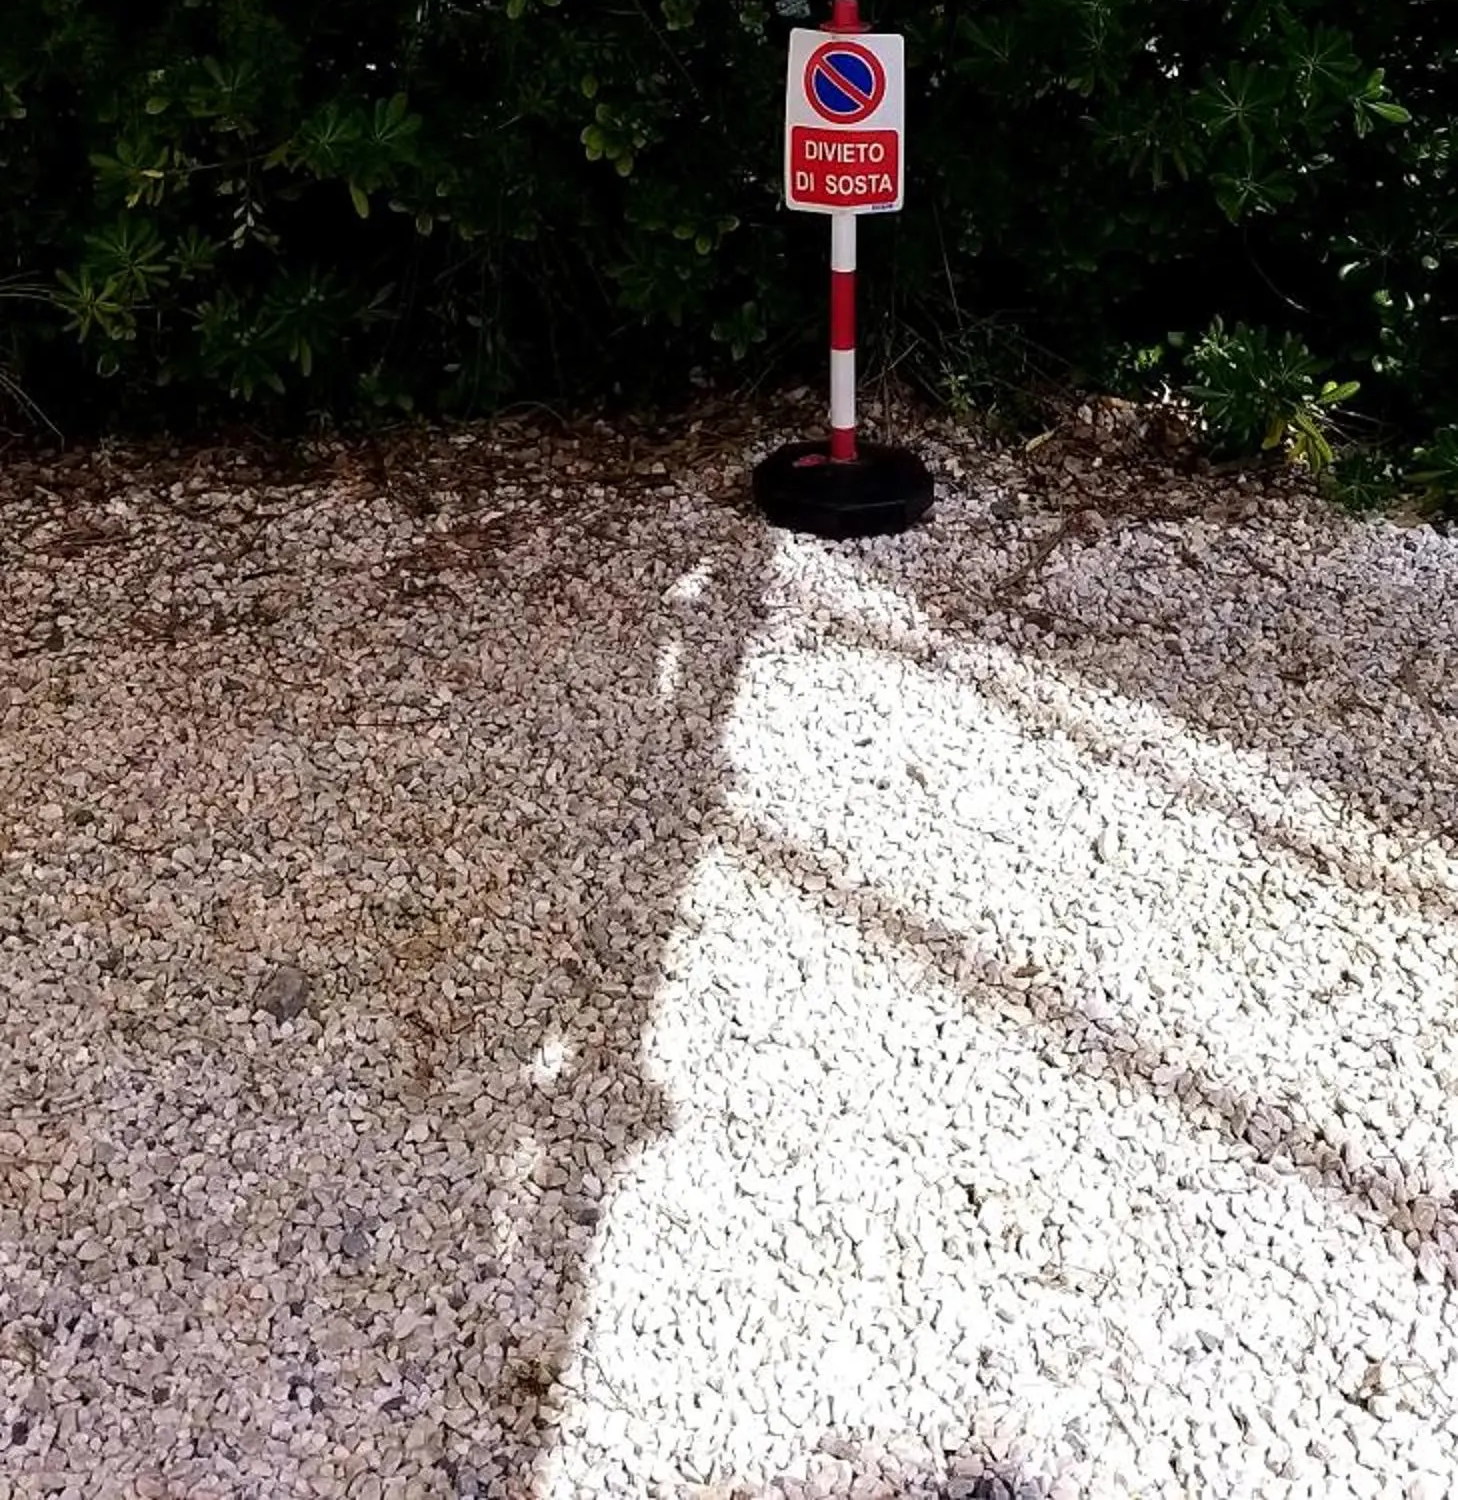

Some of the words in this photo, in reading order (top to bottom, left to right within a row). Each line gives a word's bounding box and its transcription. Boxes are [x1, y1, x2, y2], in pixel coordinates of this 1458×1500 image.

[804, 140, 885, 163] DIVIETO
[795, 171, 815, 192] DI
[825, 173, 893, 195] SOSTA
